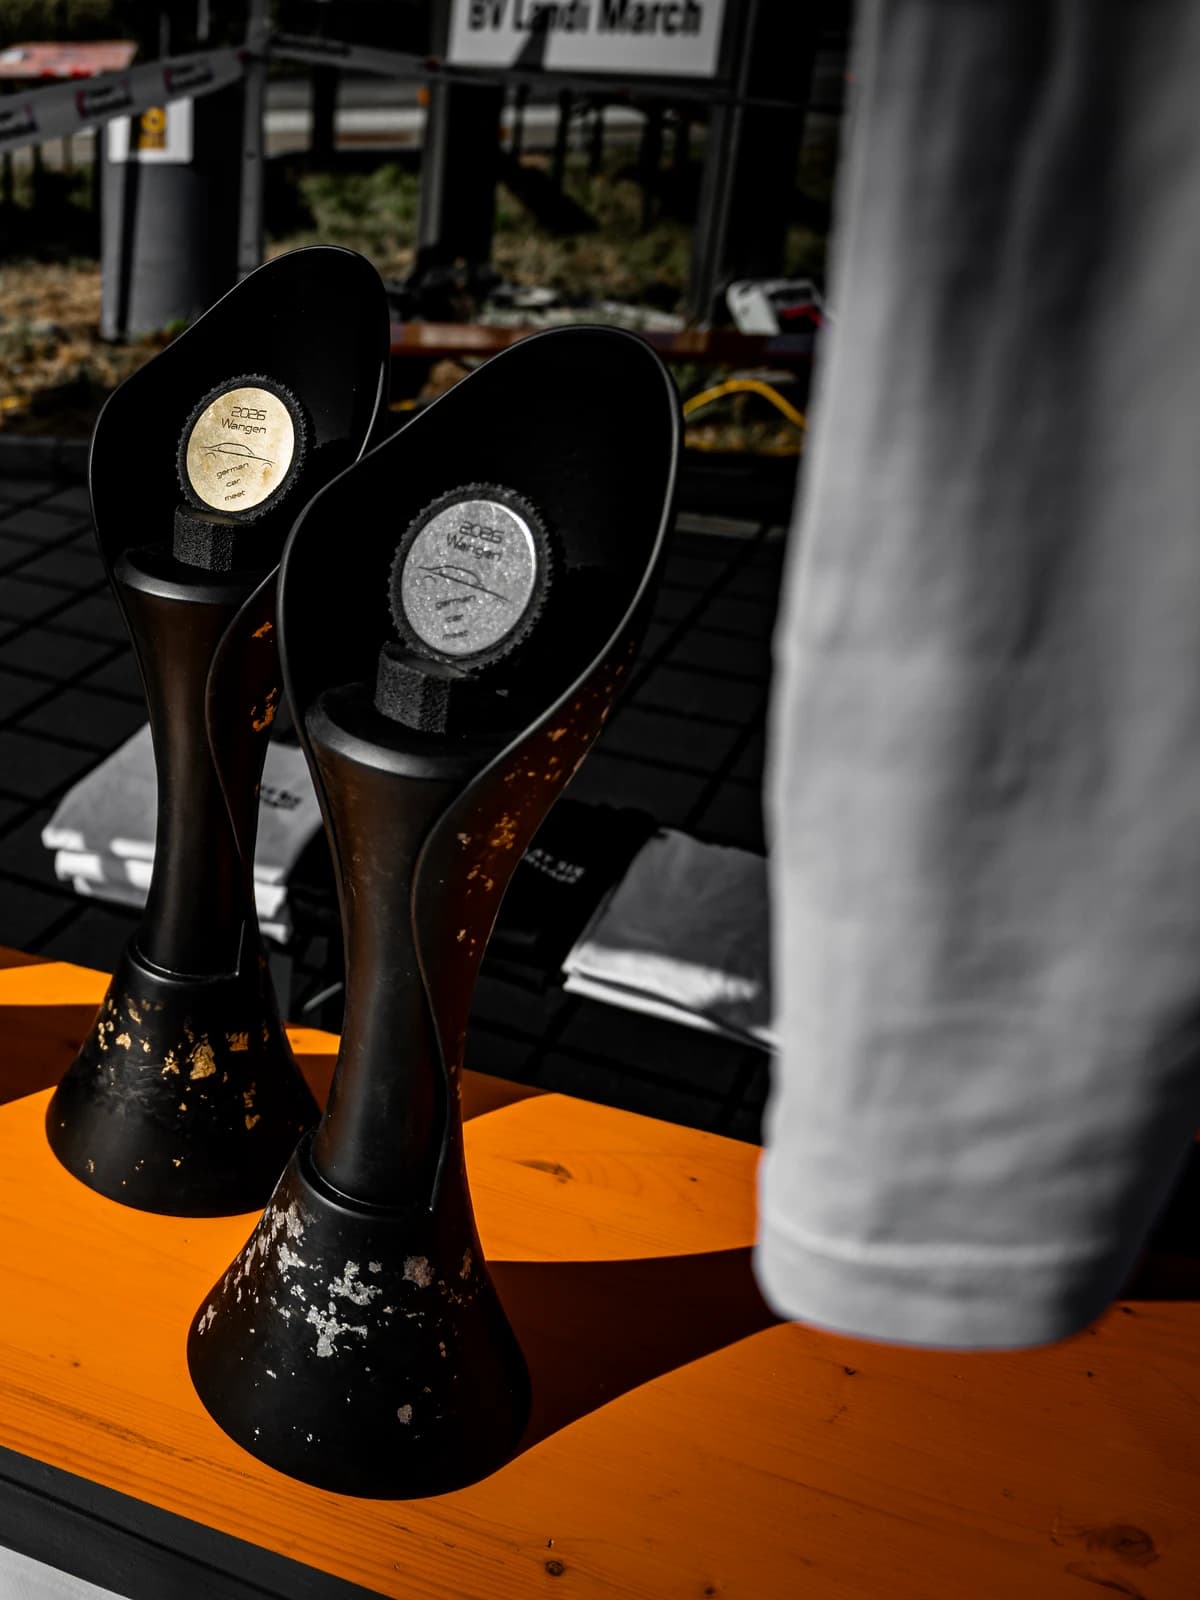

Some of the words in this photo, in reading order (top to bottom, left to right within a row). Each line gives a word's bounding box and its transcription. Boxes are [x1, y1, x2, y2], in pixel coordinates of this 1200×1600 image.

[469, 0, 504, 33] BV
[597, 0, 702, 37] March
[231, 406, 267, 420] 2026
[221, 418, 267, 434] Wangen
[216, 462, 249, 479] german
[226, 478, 241, 487] car
[224, 490, 246, 501] meet
[447, 533, 503, 562] Wangen
